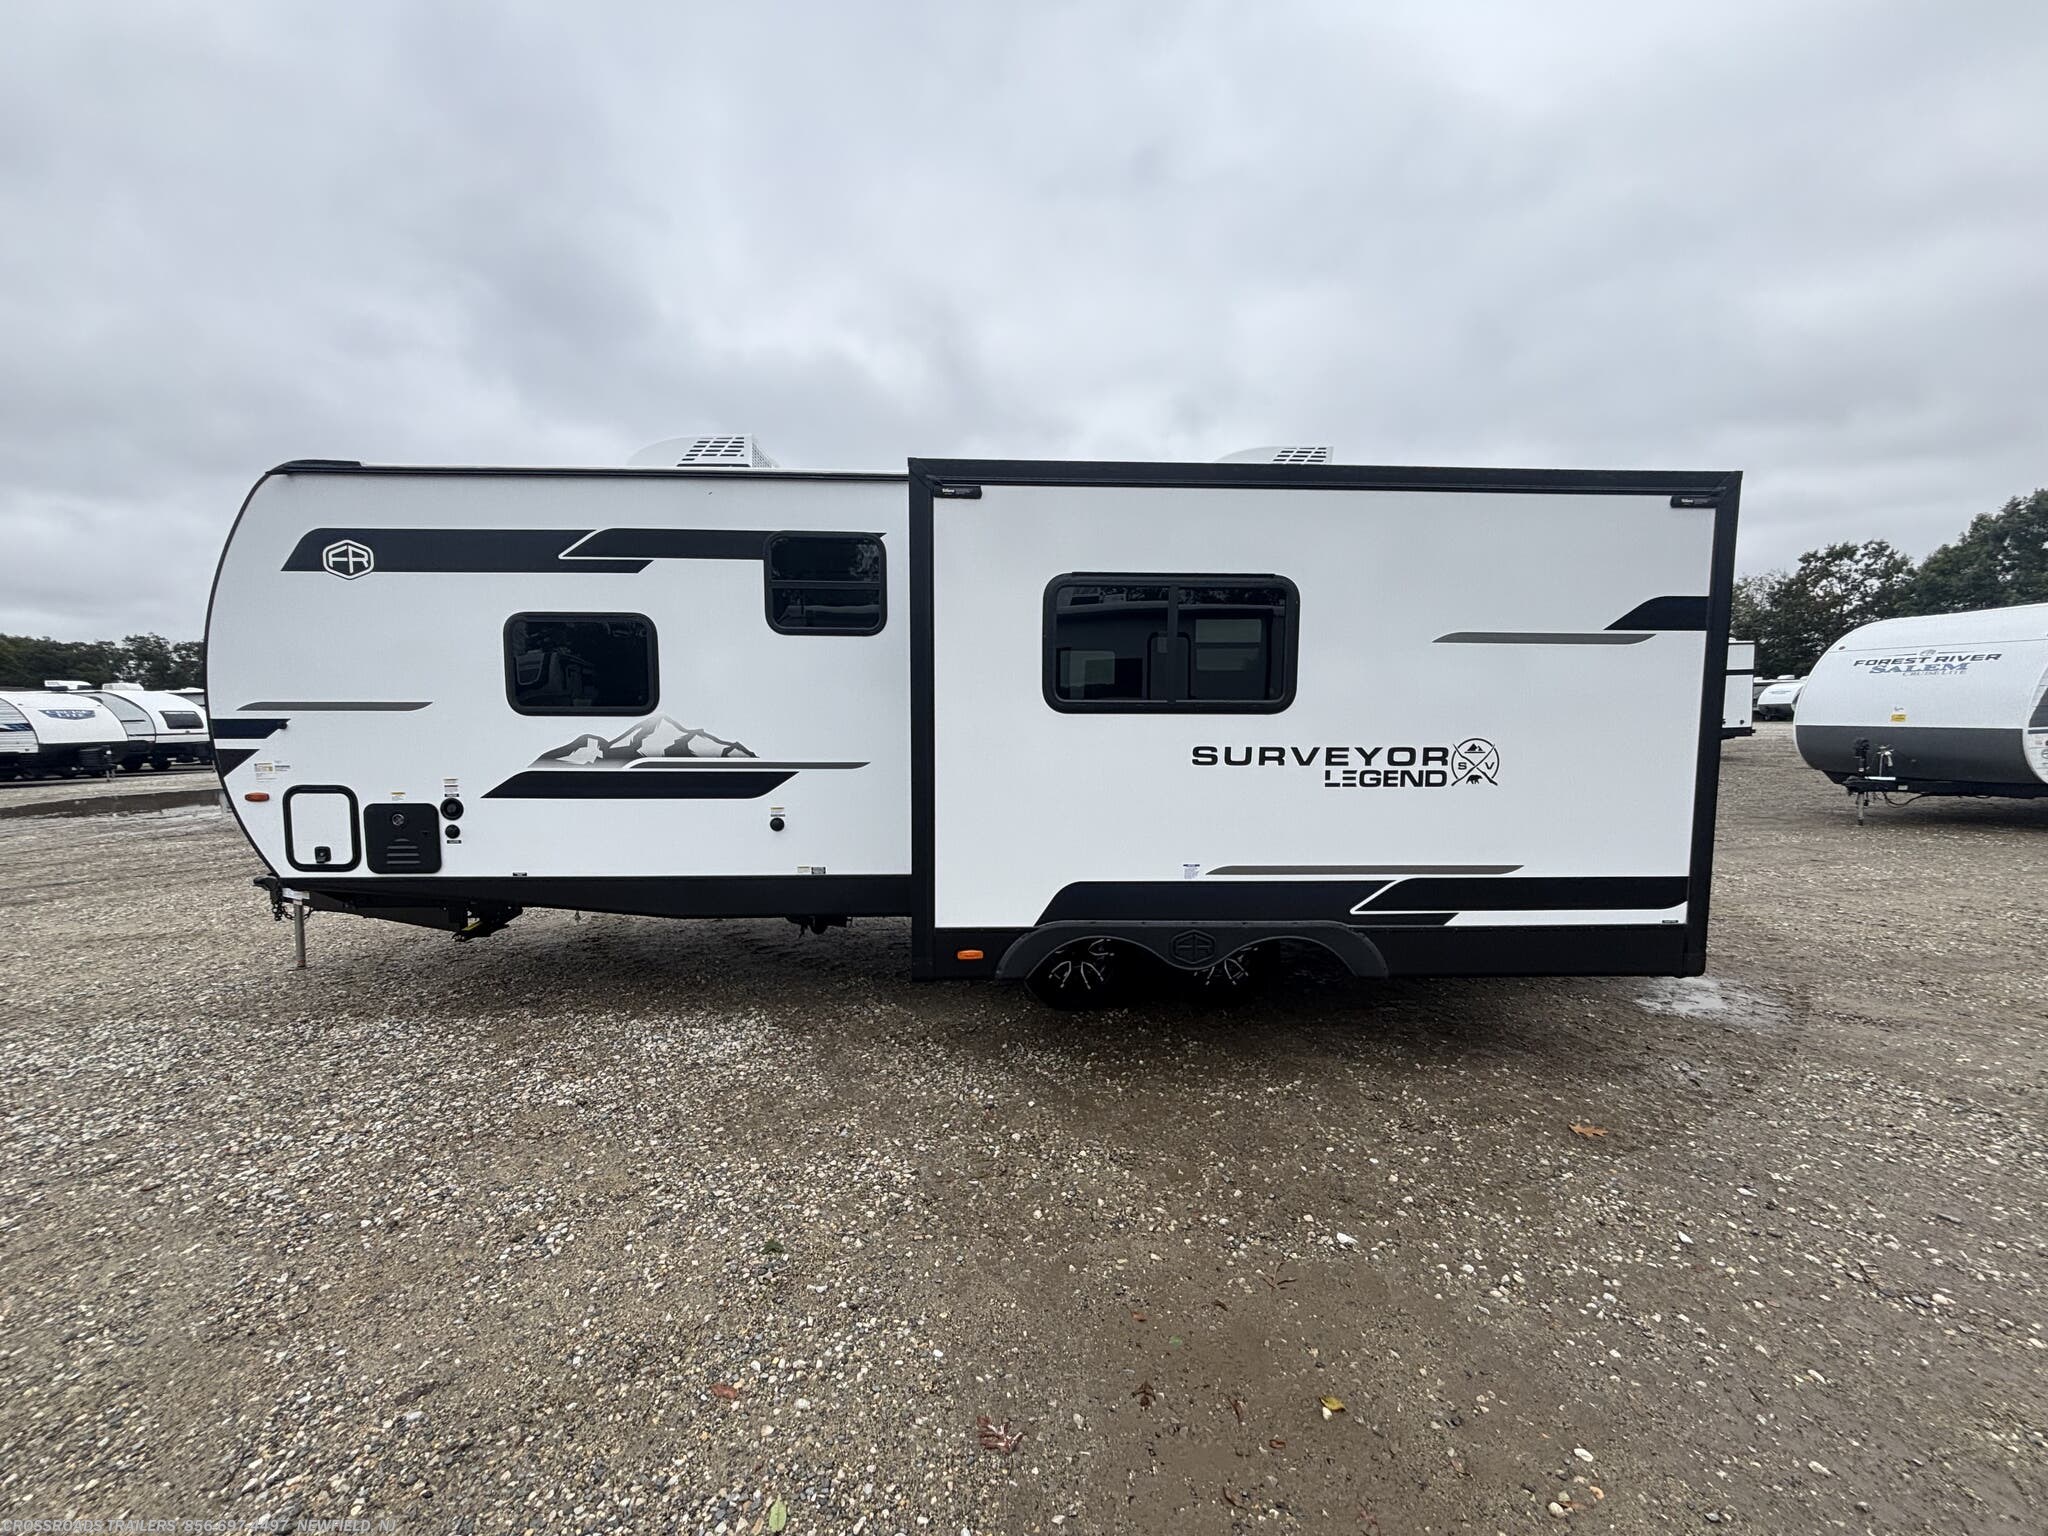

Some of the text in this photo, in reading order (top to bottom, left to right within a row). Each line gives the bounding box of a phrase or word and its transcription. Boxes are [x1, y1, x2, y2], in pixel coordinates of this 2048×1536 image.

[1853, 653, 2003, 667] FOREST RIVER
[1869, 663, 1970, 674] SALEM
[1191, 745, 1449, 767] SURVEYOR
[1457, 761, 1496, 771] S V
[1324, 769, 1448, 788] LEGEND
